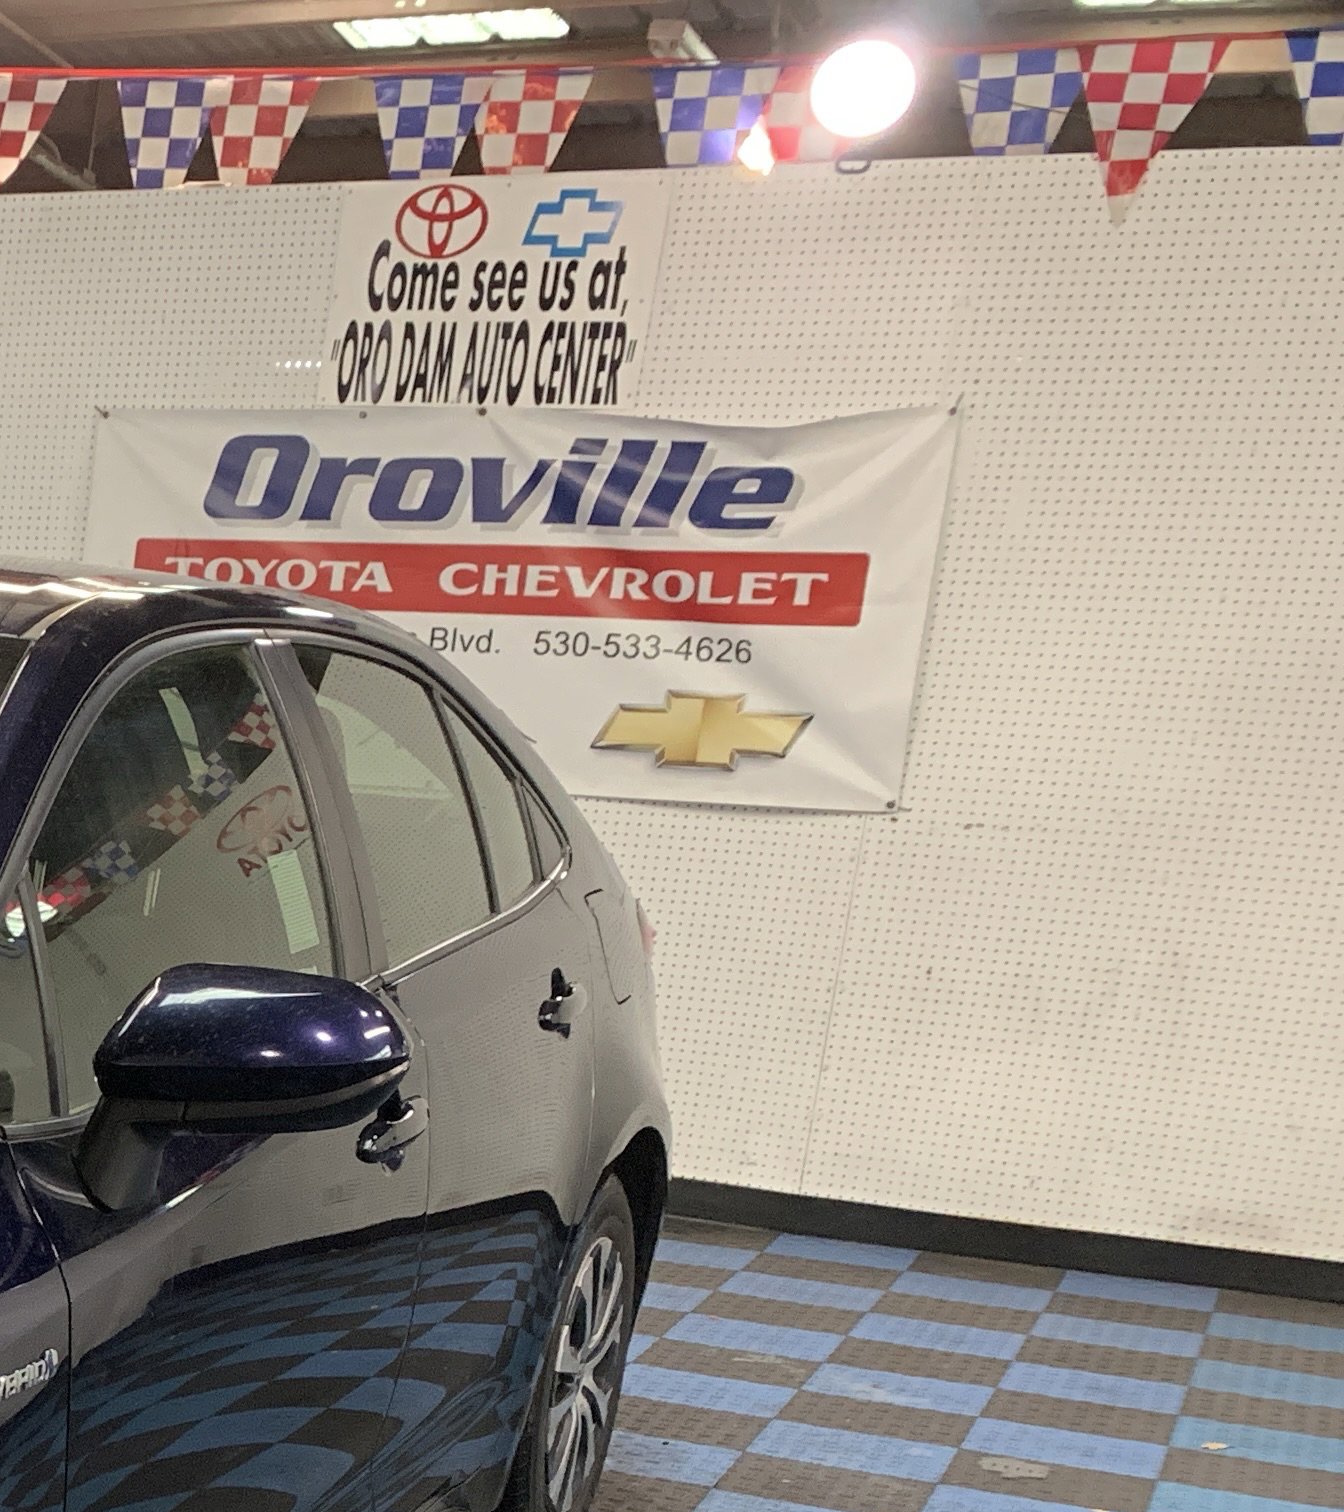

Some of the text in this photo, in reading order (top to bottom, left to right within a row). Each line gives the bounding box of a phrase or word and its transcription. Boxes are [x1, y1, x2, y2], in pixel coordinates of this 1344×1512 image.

[368, 239, 628, 317] Come see us at,
[331, 319, 638, 406] "ORO DAM AUTO CENTER"
[203, 434, 796, 531] Oroville
[164, 557, 829, 606] TOYOTA CHEVROLET
[429, 626, 753, 664] Blvd. 530-533-4626
